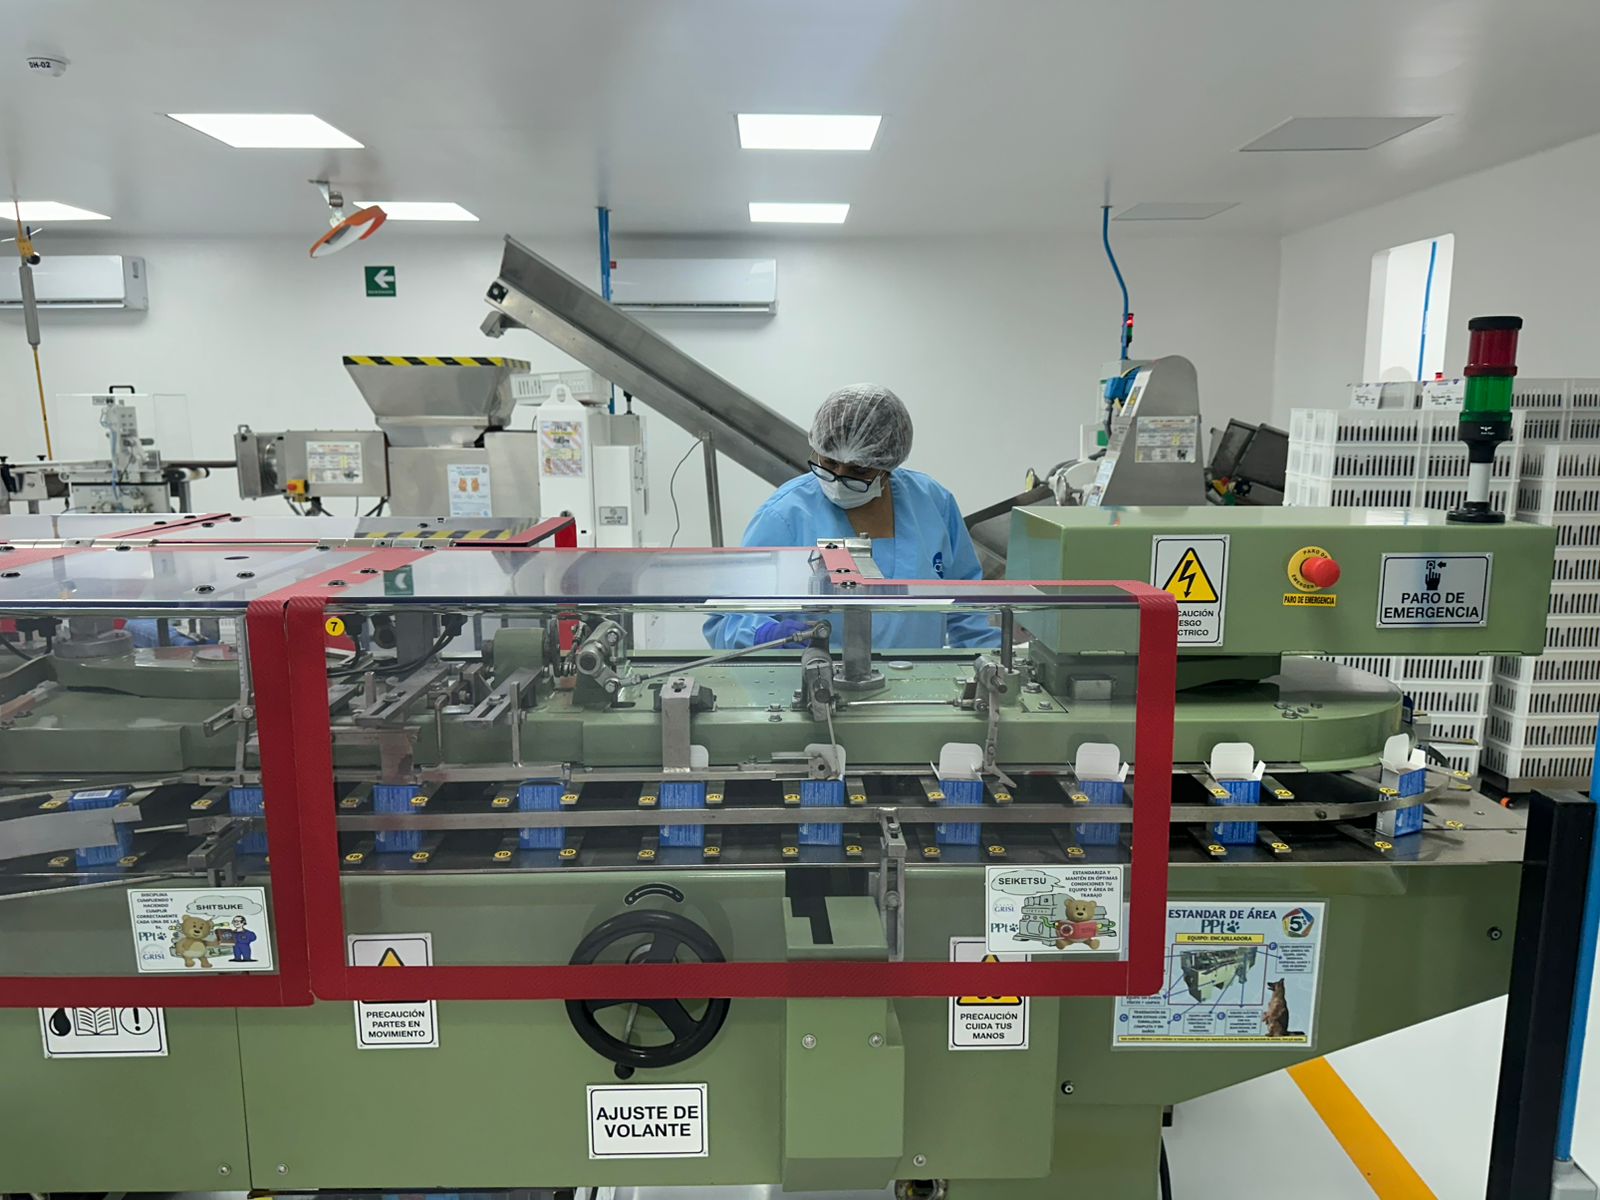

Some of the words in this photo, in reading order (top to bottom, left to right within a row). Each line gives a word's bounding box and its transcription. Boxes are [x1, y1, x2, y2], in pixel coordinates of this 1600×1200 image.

[1284, 595, 1297, 604] PARO
[1297, 596, 1304, 604] DE
[1305, 596, 1335, 605] EMERGENCIA
[1401, 592, 1441, 604] PARO
[1445, 592, 1465, 604] DE
[1177, 608, 1214, 617] CAUCIÓN
[1383, 606, 1480, 619] EMERGENCIA
[330, 621, 339, 632] 7
[1179, 619, 1202, 627] ESGO
[998, 876, 1047, 885] SEIKETSU
[195, 903, 244, 911] SHITSUKE
[994, 905, 1015, 913] GRISI
[1168, 909, 1226, 919] ESTANDAR
[1229, 910, 1244, 919] DE
[1246, 907, 1277, 920] ÁREA
[142, 953, 165, 961] GRISI
[366, 1009, 425, 1018] PRECAUCIÓN
[960, 1011, 1018, 1021] PRECAUCIÓN
[368, 1030, 426, 1038] MOVIMIENTO
[972, 1032, 1005, 1040] MANOS
[596, 1105, 668, 1120] AJUSTE
[674, 1105, 699, 1119] DE
[604, 1123, 691, 1138] VOLANTE
